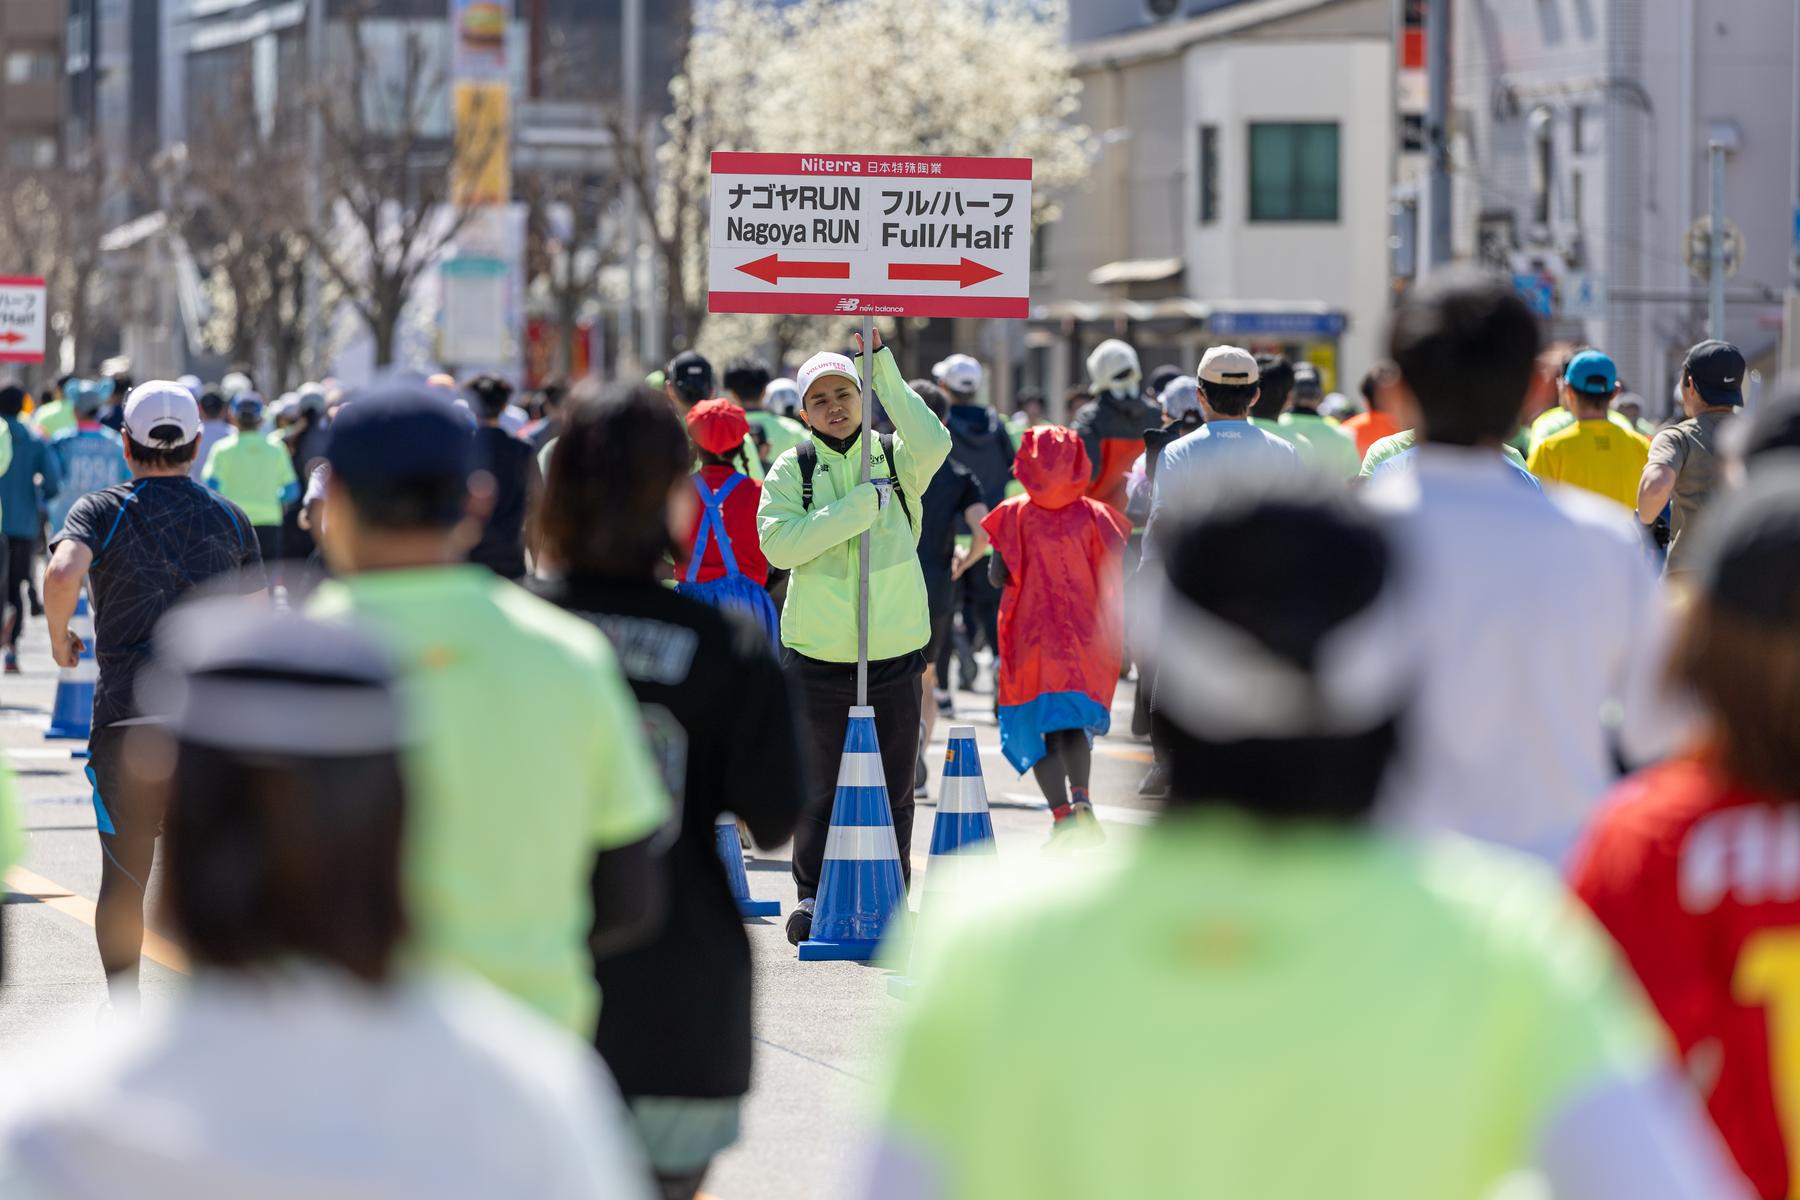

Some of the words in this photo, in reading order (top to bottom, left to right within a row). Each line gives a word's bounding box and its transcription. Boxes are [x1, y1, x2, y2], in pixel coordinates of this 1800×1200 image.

[801, 158, 861, 173] Niterra
[867, 161, 943, 175] 日本特殊陶業
[728, 183, 860, 211] ナゴヤRUN
[881, 190, 1014, 217] フル/ハーフ
[727, 216, 806, 246] Nagoya
[813, 218, 860, 244] RUN
[882, 222, 1014, 249] Full/Half
[860, 304, 874, 312] new
[875, 304, 905, 313] balance
